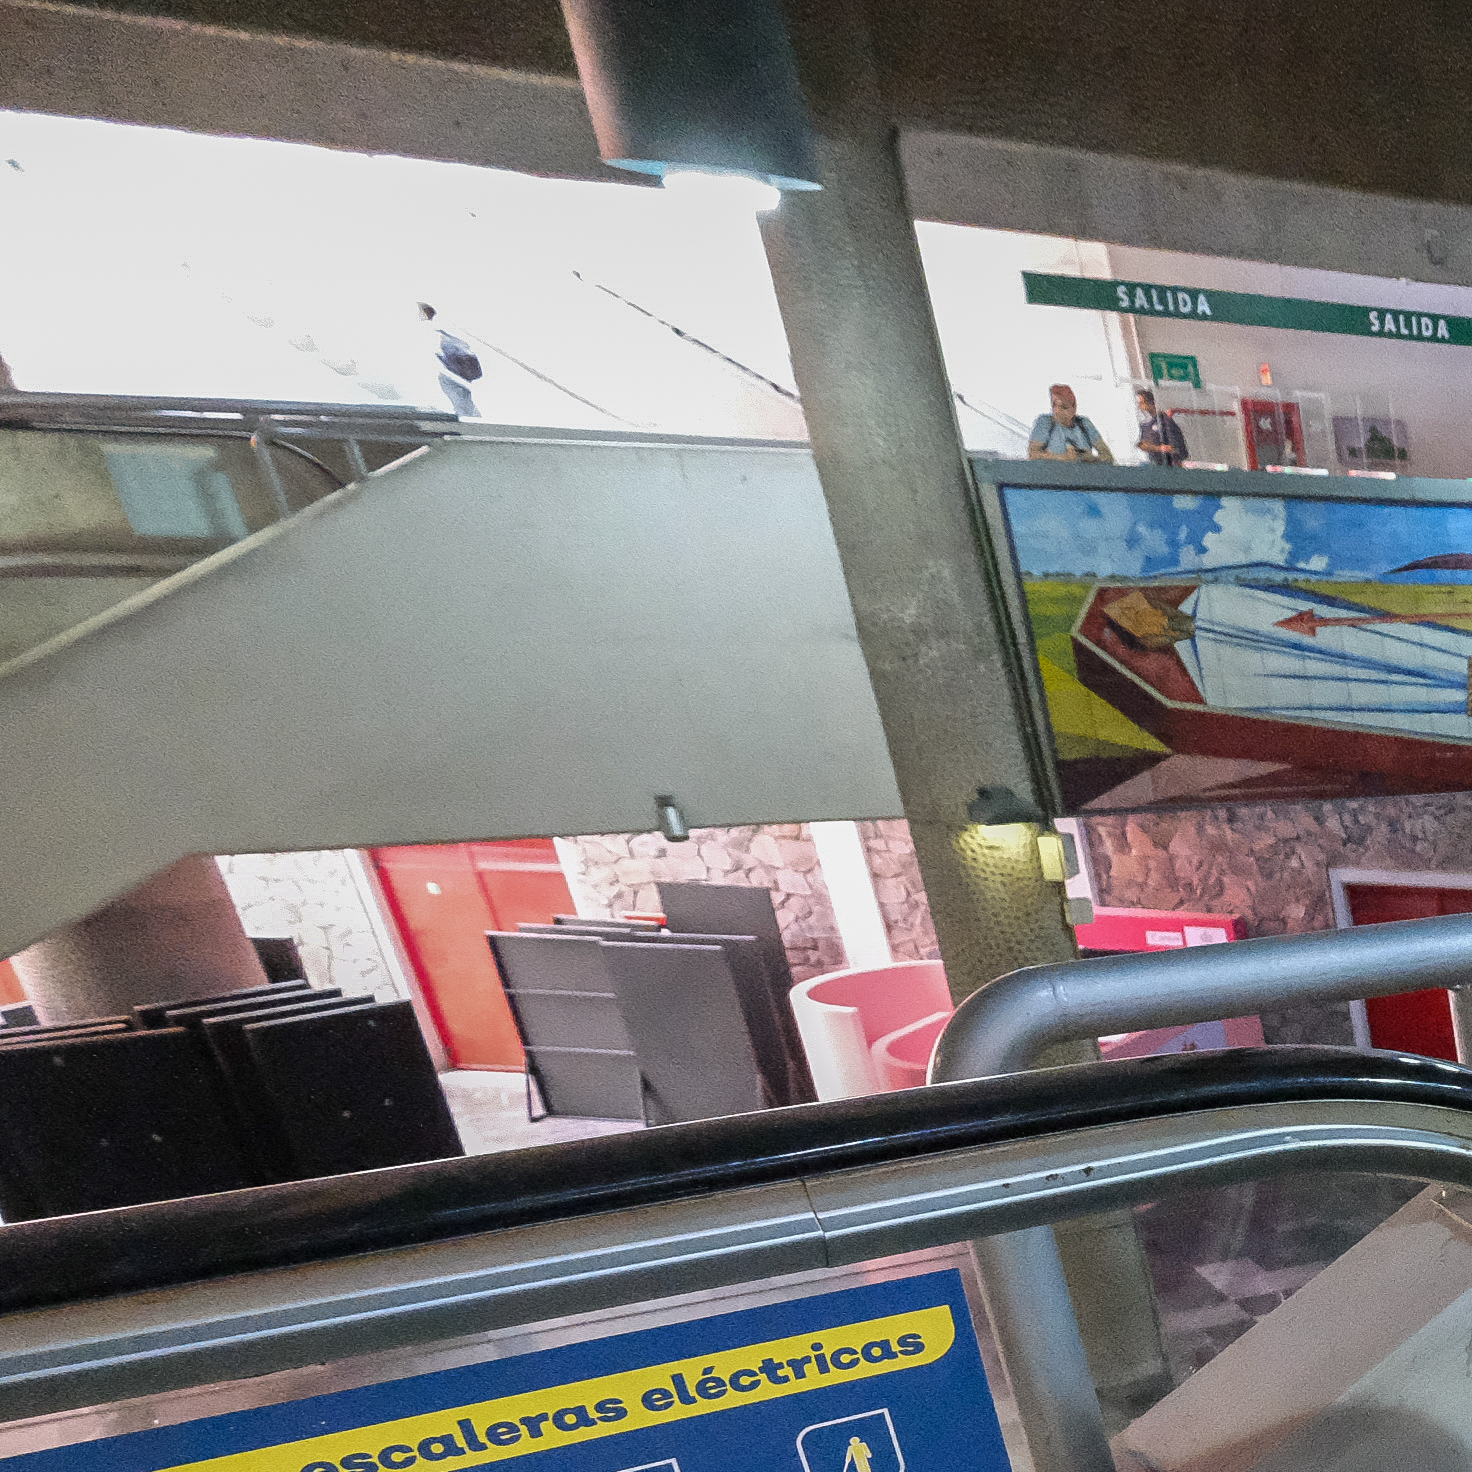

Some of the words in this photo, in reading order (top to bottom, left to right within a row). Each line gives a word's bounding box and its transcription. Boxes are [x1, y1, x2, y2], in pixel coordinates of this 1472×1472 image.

[1115, 284, 1213, 316] SALIDA
[1368, 310, 1450, 340] SALIDA
[640, 1327, 926, 1413] eléctricas
